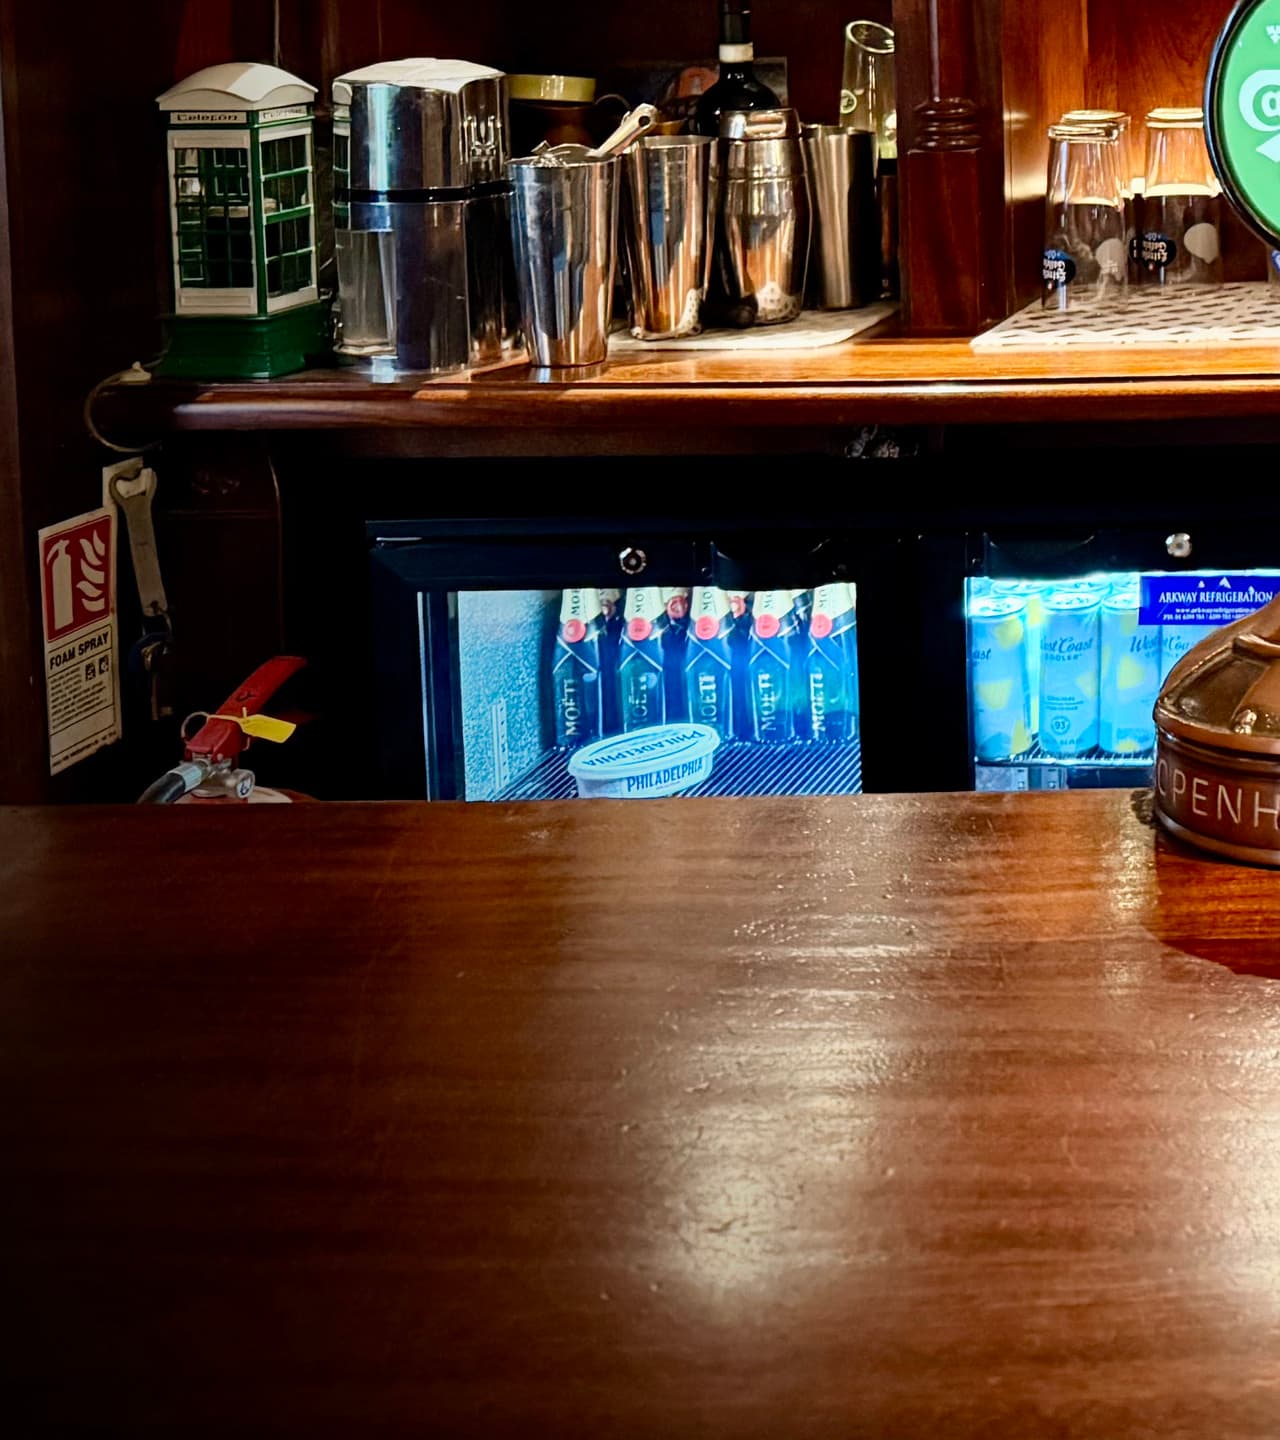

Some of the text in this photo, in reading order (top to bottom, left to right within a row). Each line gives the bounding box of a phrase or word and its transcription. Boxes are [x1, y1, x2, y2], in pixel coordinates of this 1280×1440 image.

[1158, 591, 1274, 604] ARKWAY REFRIGERATION
[49, 631, 110, 671] FOAM SPRAY
[1058, 636, 1095, 654] Coast
[582, 729, 706, 767] PHILADELPHIA
[626, 758, 704, 793] PHILADELPHIA
